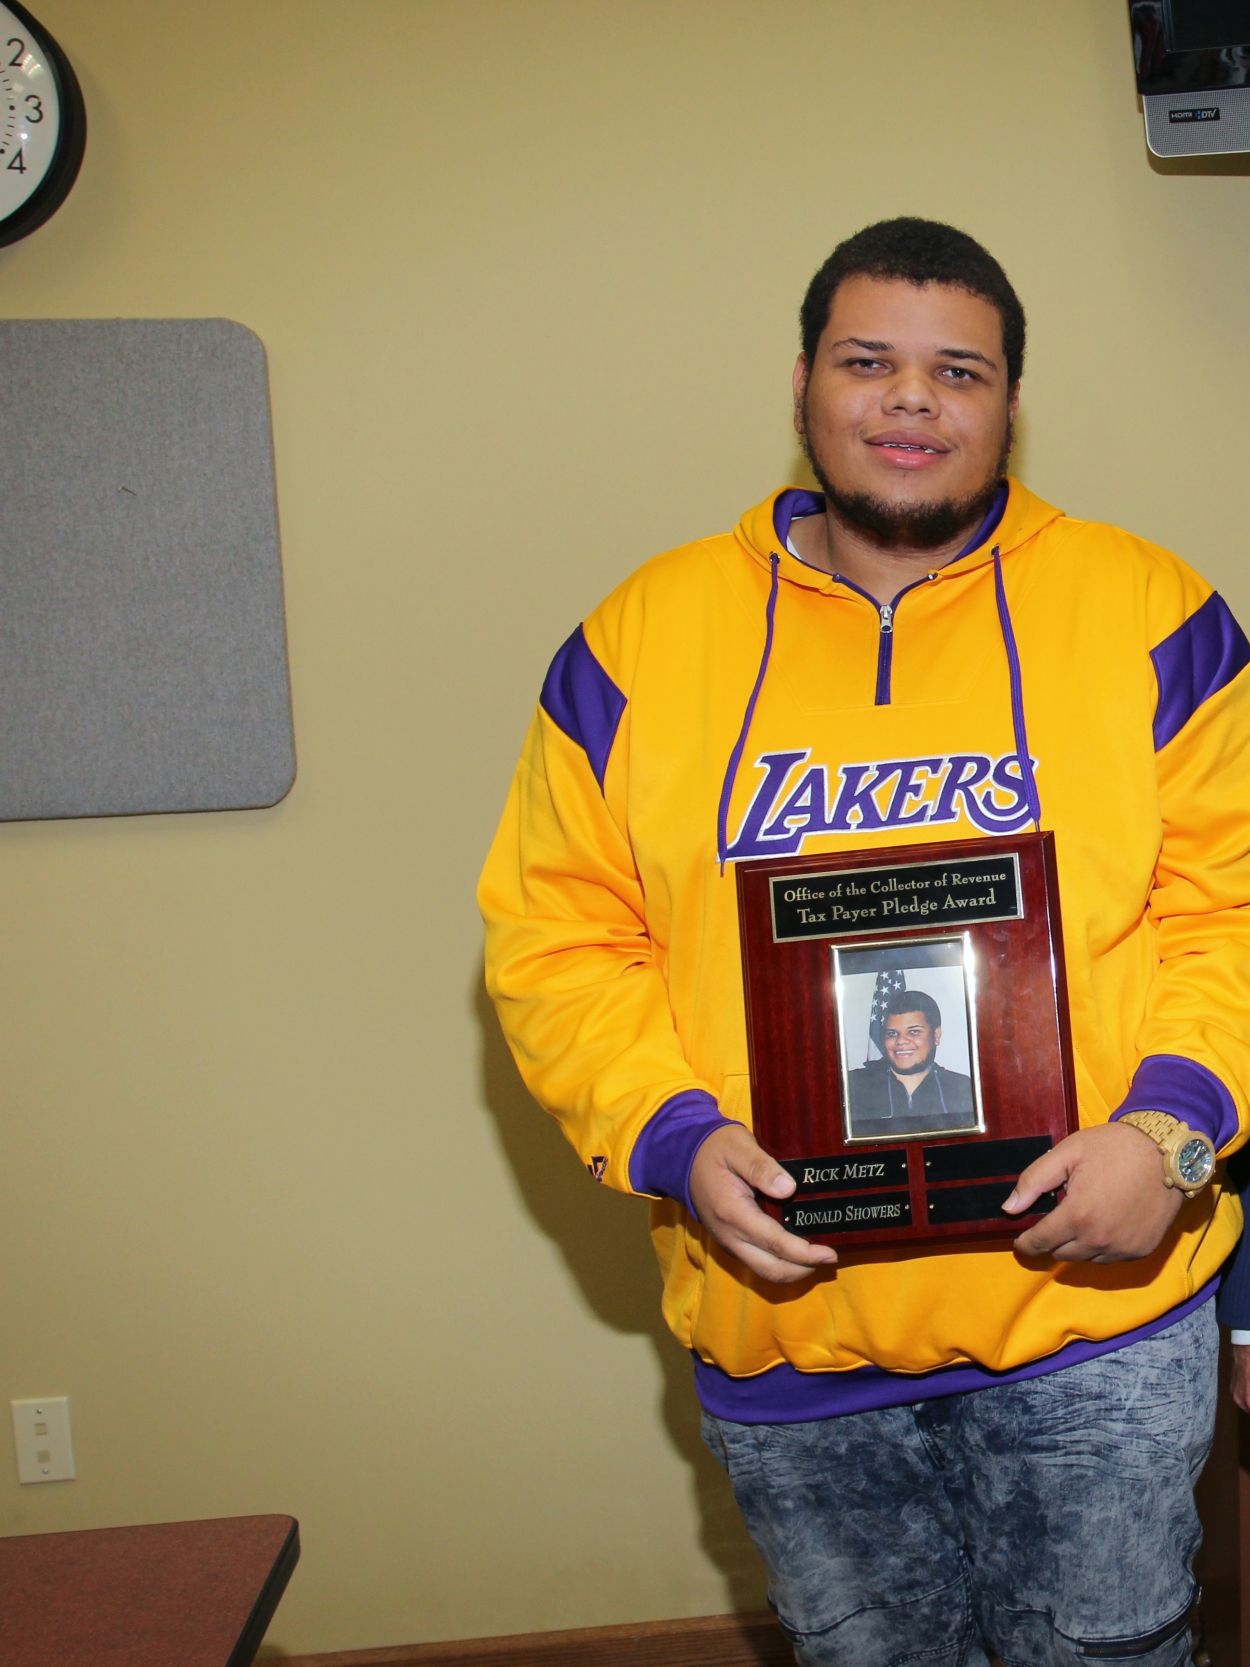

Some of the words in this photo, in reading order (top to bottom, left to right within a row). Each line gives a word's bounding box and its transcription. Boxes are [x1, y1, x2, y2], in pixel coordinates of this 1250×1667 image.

[7, 38, 25, 67] 2
[24, 94, 44, 124] 3
[1195, 109, 1217, 120] HDTV
[7, 147, 27, 174] 4
[717, 748, 1039, 862] LAKERS
[784, 887, 825, 902] Office
[829, 883, 842, 898] of
[846, 882, 867, 896] the
[870, 878, 930, 893] Collector
[934, 873, 948, 887] of
[951, 873, 1007, 886] Revenue
[797, 907, 827, 924] Tax
[832, 905, 877, 922] Payer
[882, 895, 938, 916] Pledge
[942, 888, 997, 910] Award
[802, 1167, 840, 1184] RICK
[843, 1163, 885, 1180] METZ
[795, 1210, 842, 1226] RONALD
[845, 1203, 901, 1221] SHOWERS
